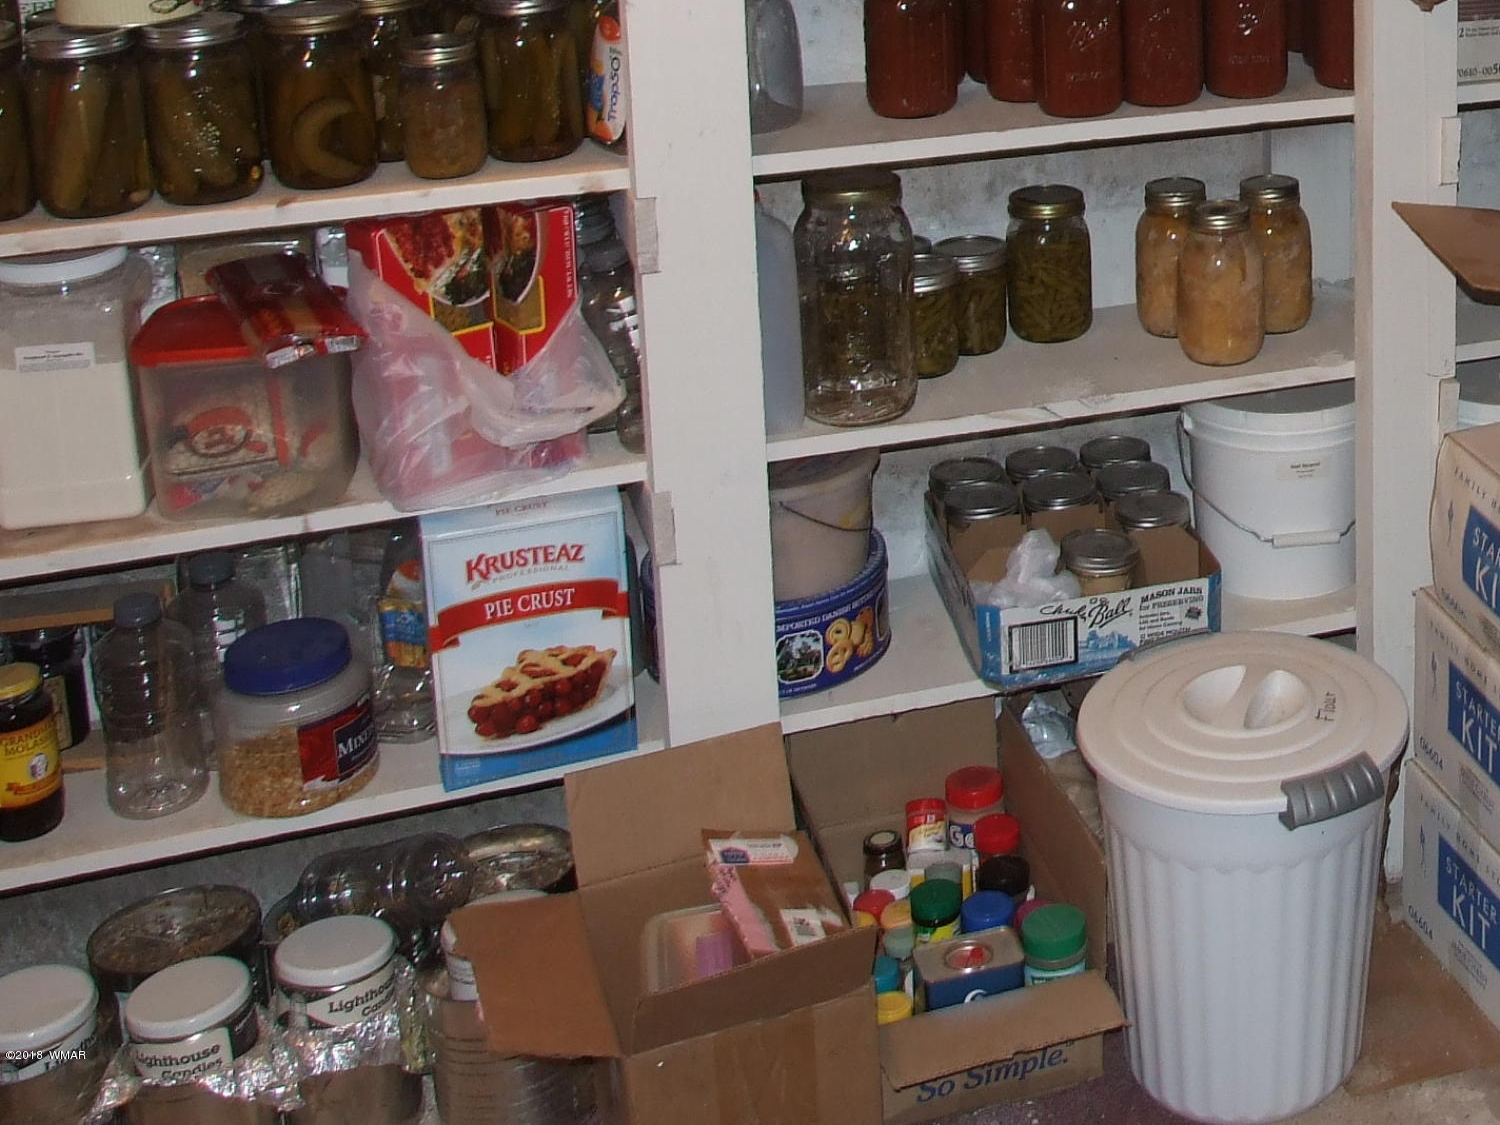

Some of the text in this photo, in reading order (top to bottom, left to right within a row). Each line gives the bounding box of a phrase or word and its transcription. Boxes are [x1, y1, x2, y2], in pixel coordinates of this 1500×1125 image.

[514, 502, 548, 514] CRUST
[465, 544, 586, 584] KRUSTEAZ
[485, 588, 576, 620] PIE CRUST
[1140, 586, 1203, 603] MASON JARS
[1151, 594, 1204, 610] PRESERVING
[1088, 597, 1134, 629] Ball
[1462, 709, 1498, 774] KIT
[1446, 856, 1498, 924] STARTER
[1453, 885, 1490, 950] KIT
[135, 1042, 221, 1068] Lighthouse
[916, 1048, 1068, 1103] So Simple.
